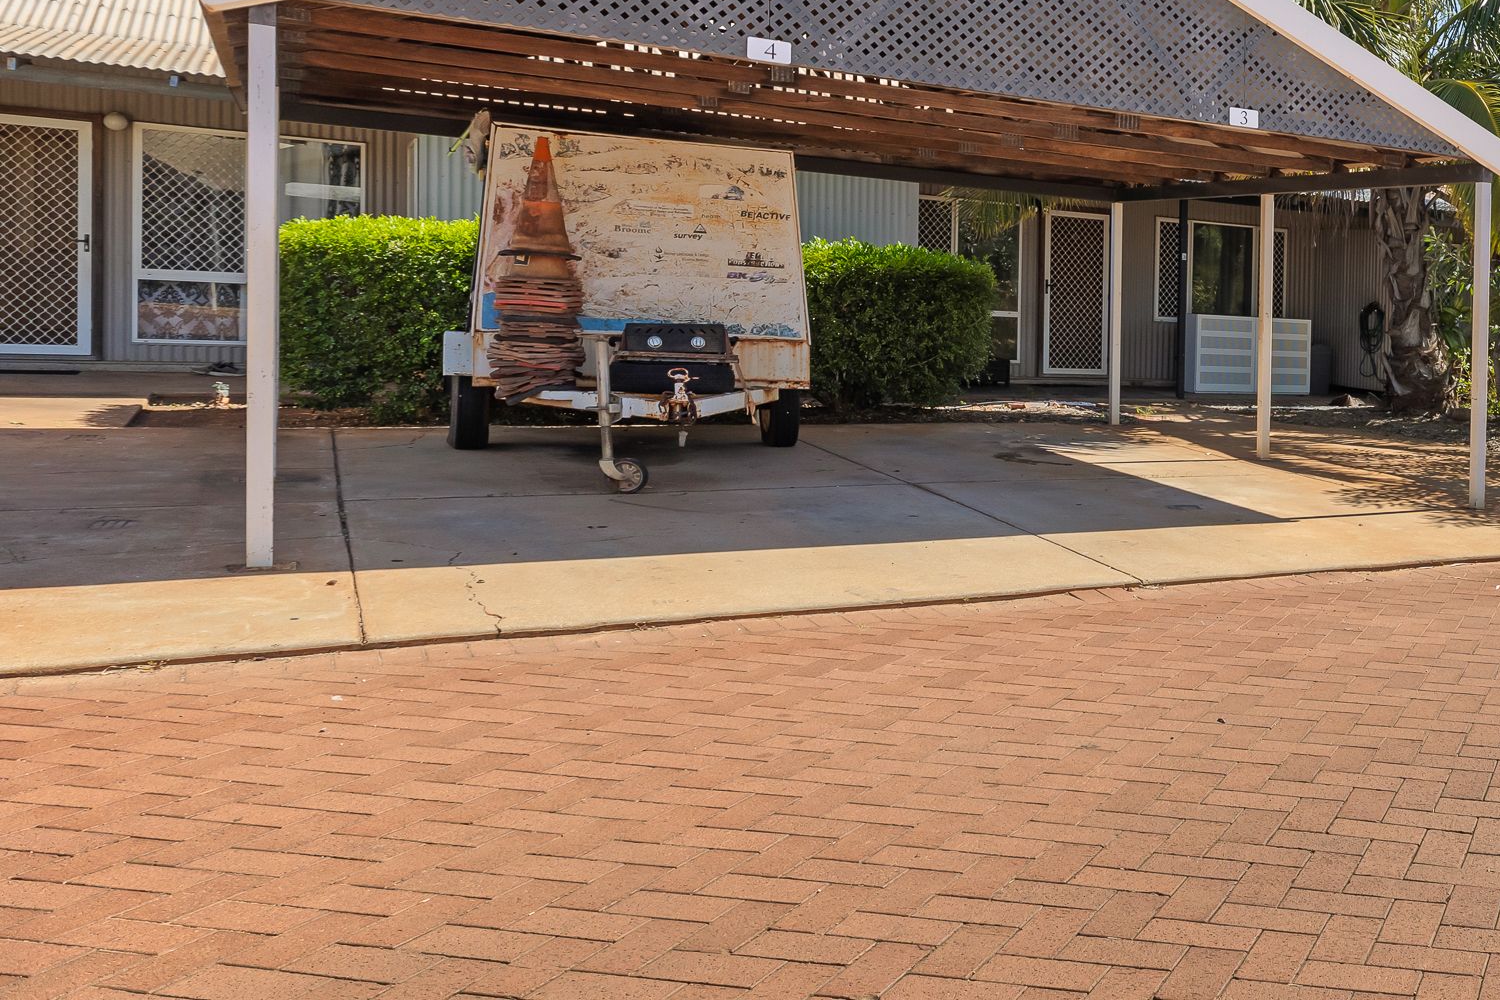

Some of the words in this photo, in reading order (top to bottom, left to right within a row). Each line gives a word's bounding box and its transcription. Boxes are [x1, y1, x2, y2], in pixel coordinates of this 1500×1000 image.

[764, 43, 776, 59] 4
[1240, 110, 1248, 125] 3
[740, 210, 753, 219] BE
[614, 224, 651, 234] Broome
[673, 232, 703, 240] survey
